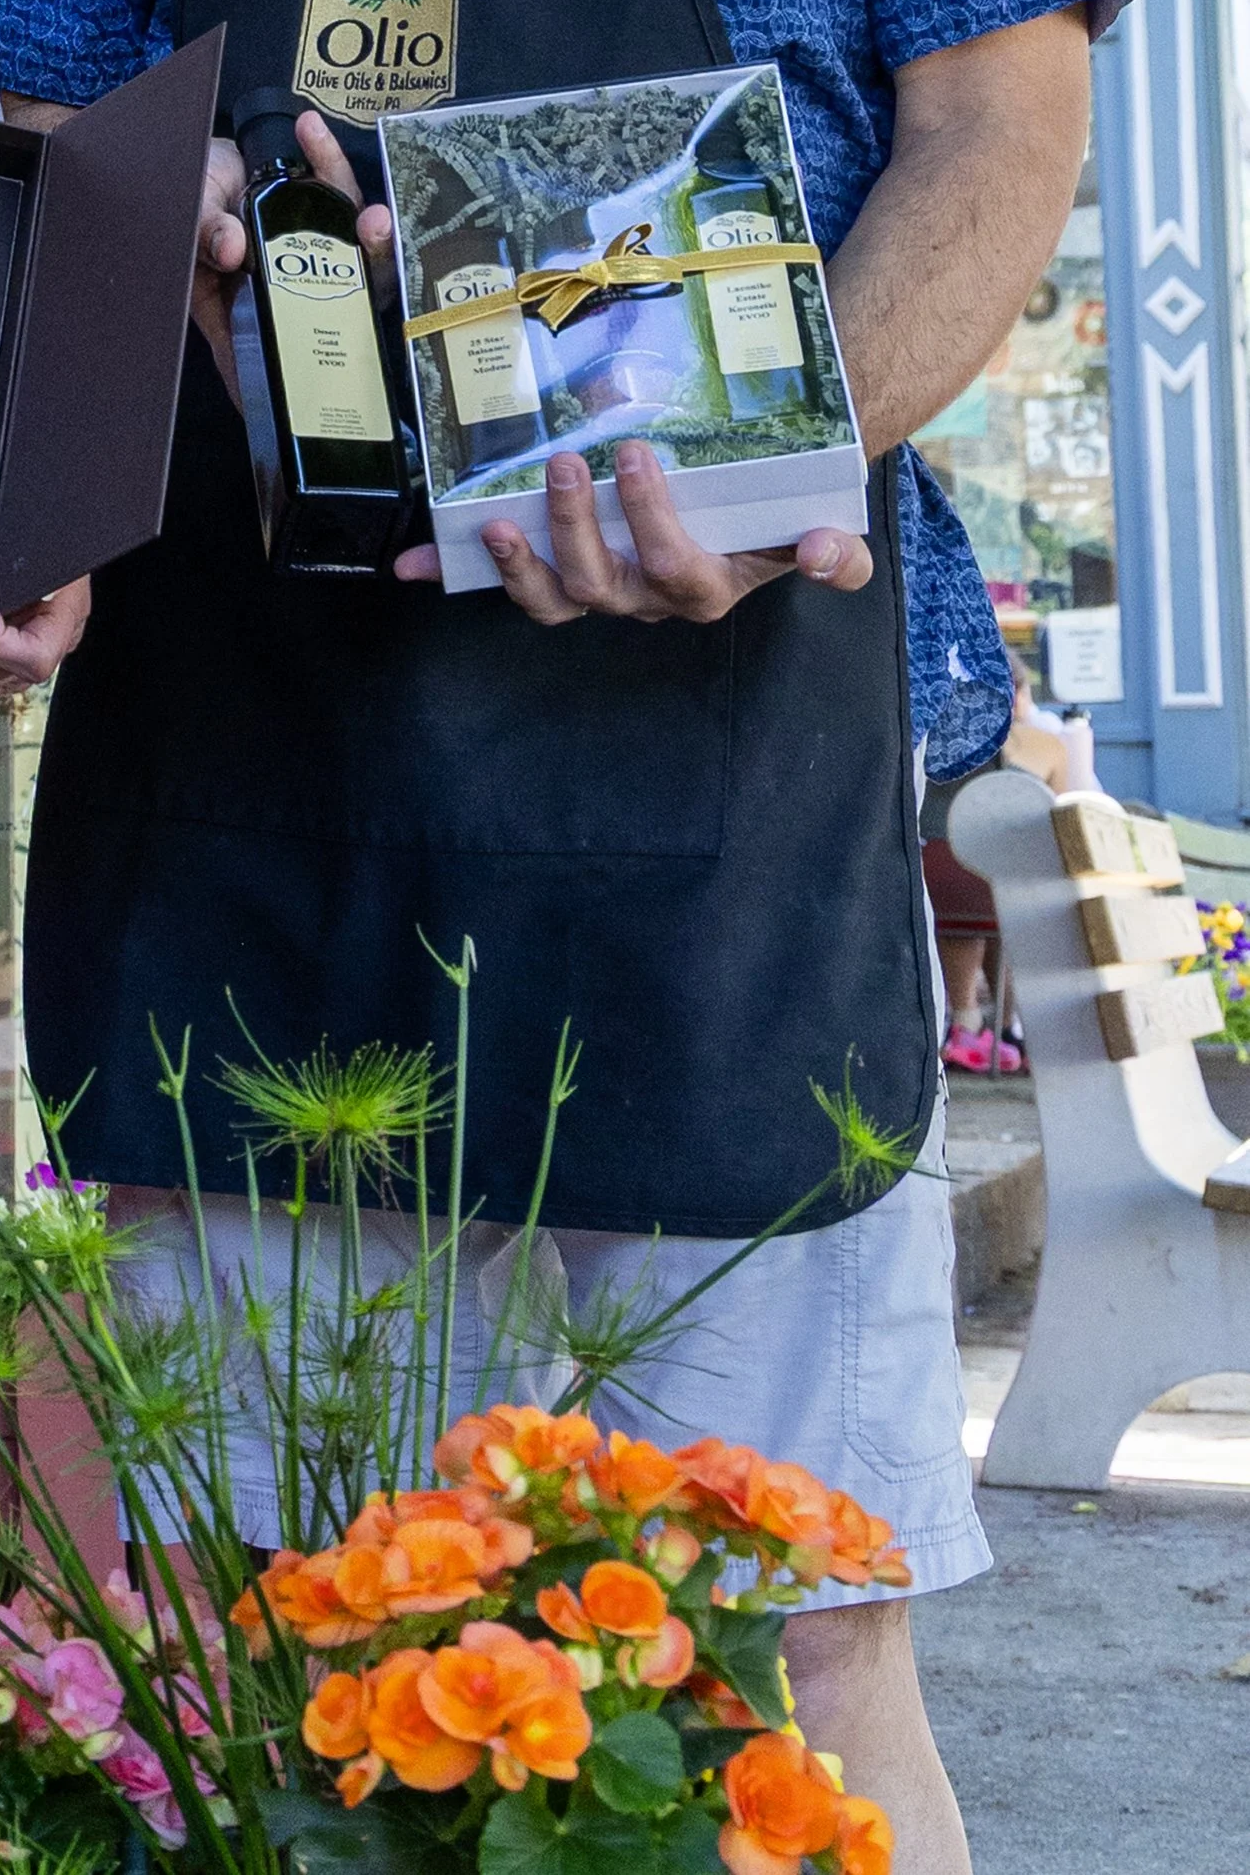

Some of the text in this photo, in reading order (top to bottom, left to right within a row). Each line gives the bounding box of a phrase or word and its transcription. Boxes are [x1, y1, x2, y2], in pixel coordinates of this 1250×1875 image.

[316, 17, 444, 68] Olio
[304, 69, 447, 92] Olive Oils & Balsamics
[384, 96, 400, 110] PA
[707, 228, 773, 248] Olio
[274, 253, 355, 279] Olio
[736, 294, 766, 303] Estate
[738, 312, 771, 321] EVOO
[484, 335, 506, 344] Star
[312, 349, 347, 358] Organic
[468, 344, 511, 357] Balsamic
[477, 355, 505, 365] From
[473, 362, 513, 374] Modena
